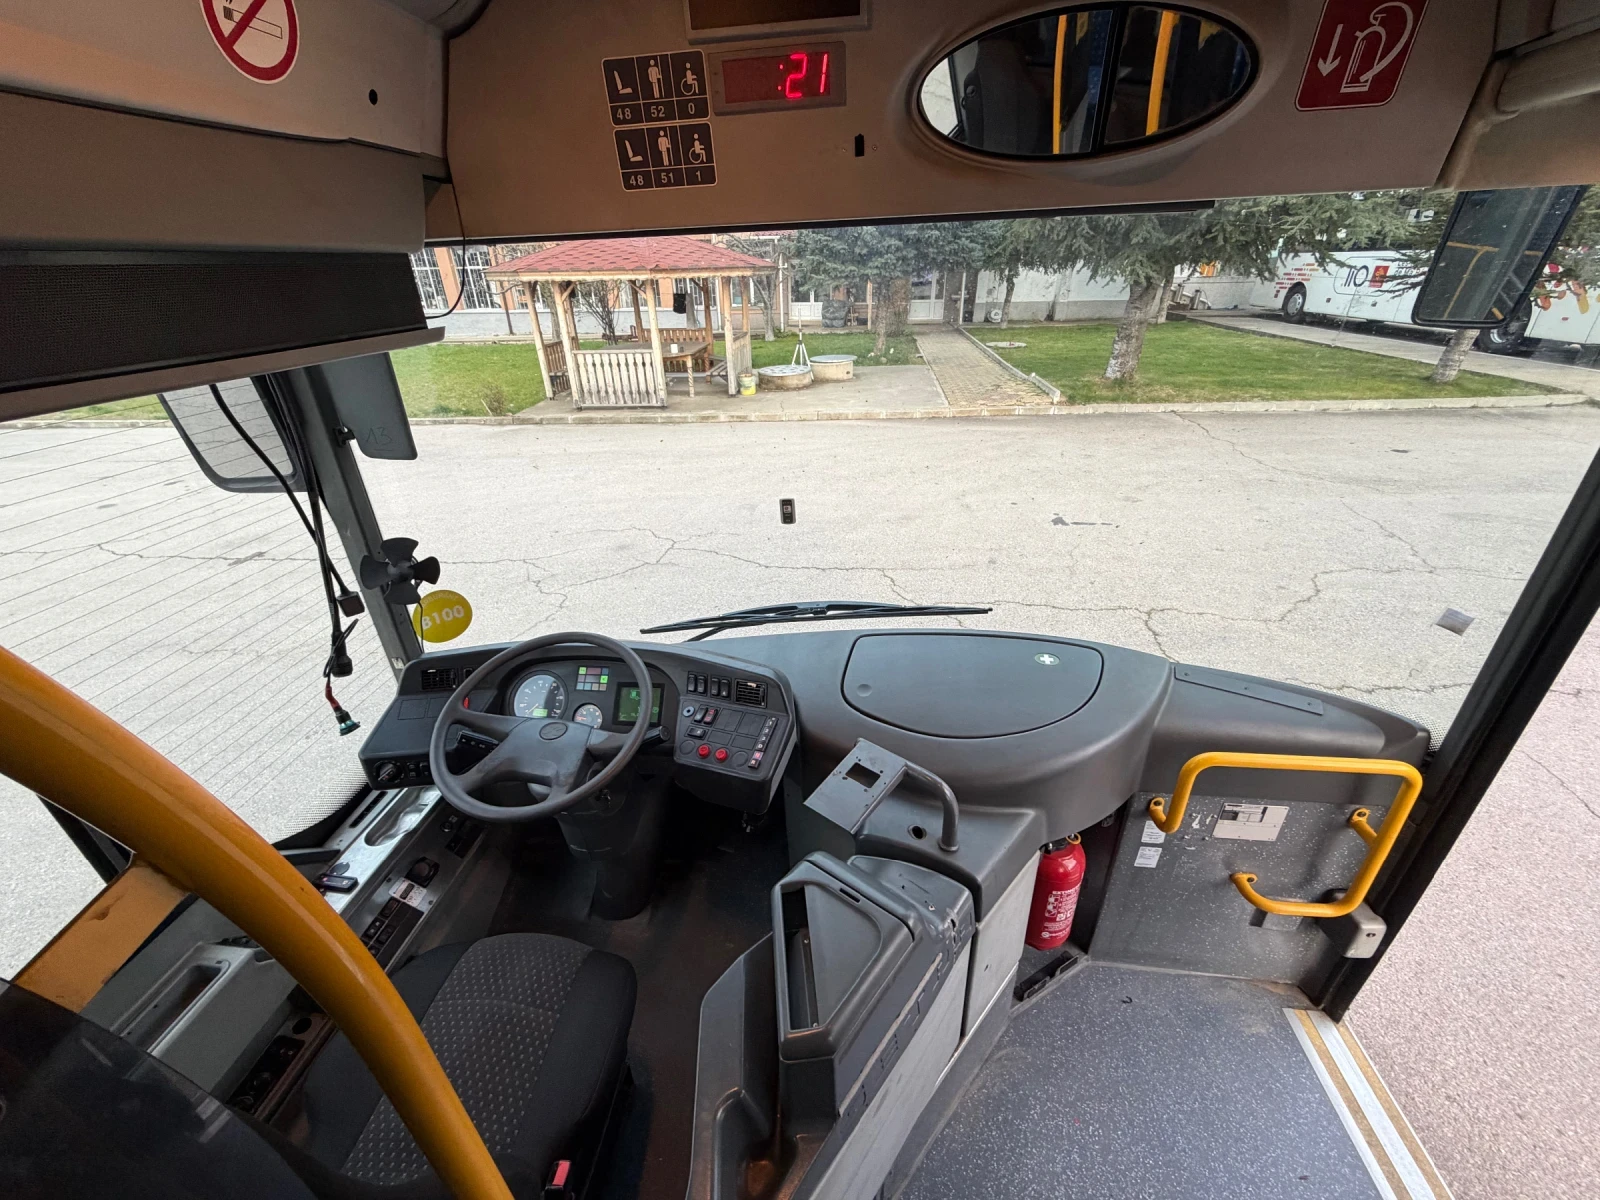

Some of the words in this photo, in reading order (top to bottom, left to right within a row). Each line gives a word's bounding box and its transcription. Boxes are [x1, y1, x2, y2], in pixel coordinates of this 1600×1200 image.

[616, 108, 632, 120] 48
[650, 105, 665, 118] 52
[687, 103, 695, 115] 0
[629, 175, 644, 186] 48
[660, 172, 674, 184] 51
[695, 170, 701, 182] 1
[421, 605, 465, 631] B100
